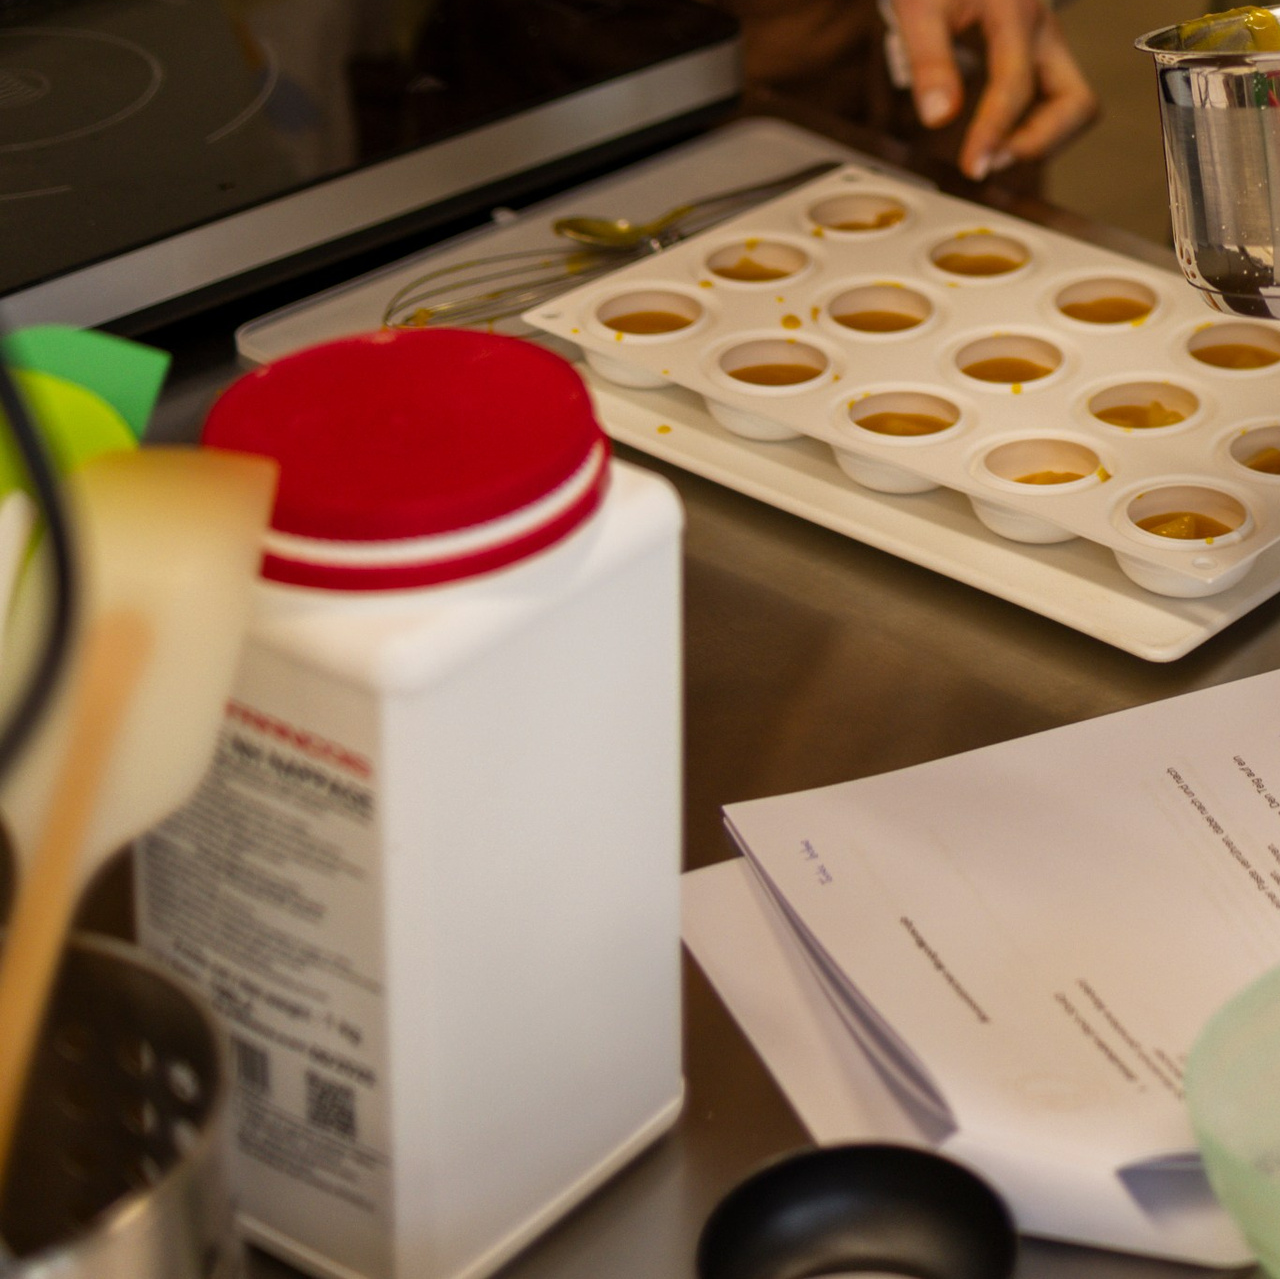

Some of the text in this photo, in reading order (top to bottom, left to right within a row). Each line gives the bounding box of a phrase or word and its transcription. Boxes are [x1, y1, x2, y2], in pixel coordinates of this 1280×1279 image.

[1166, 767, 1183, 784] nach
[1251, 777, 1266, 793] Teig
[1190, 798, 1207, 815] nach
